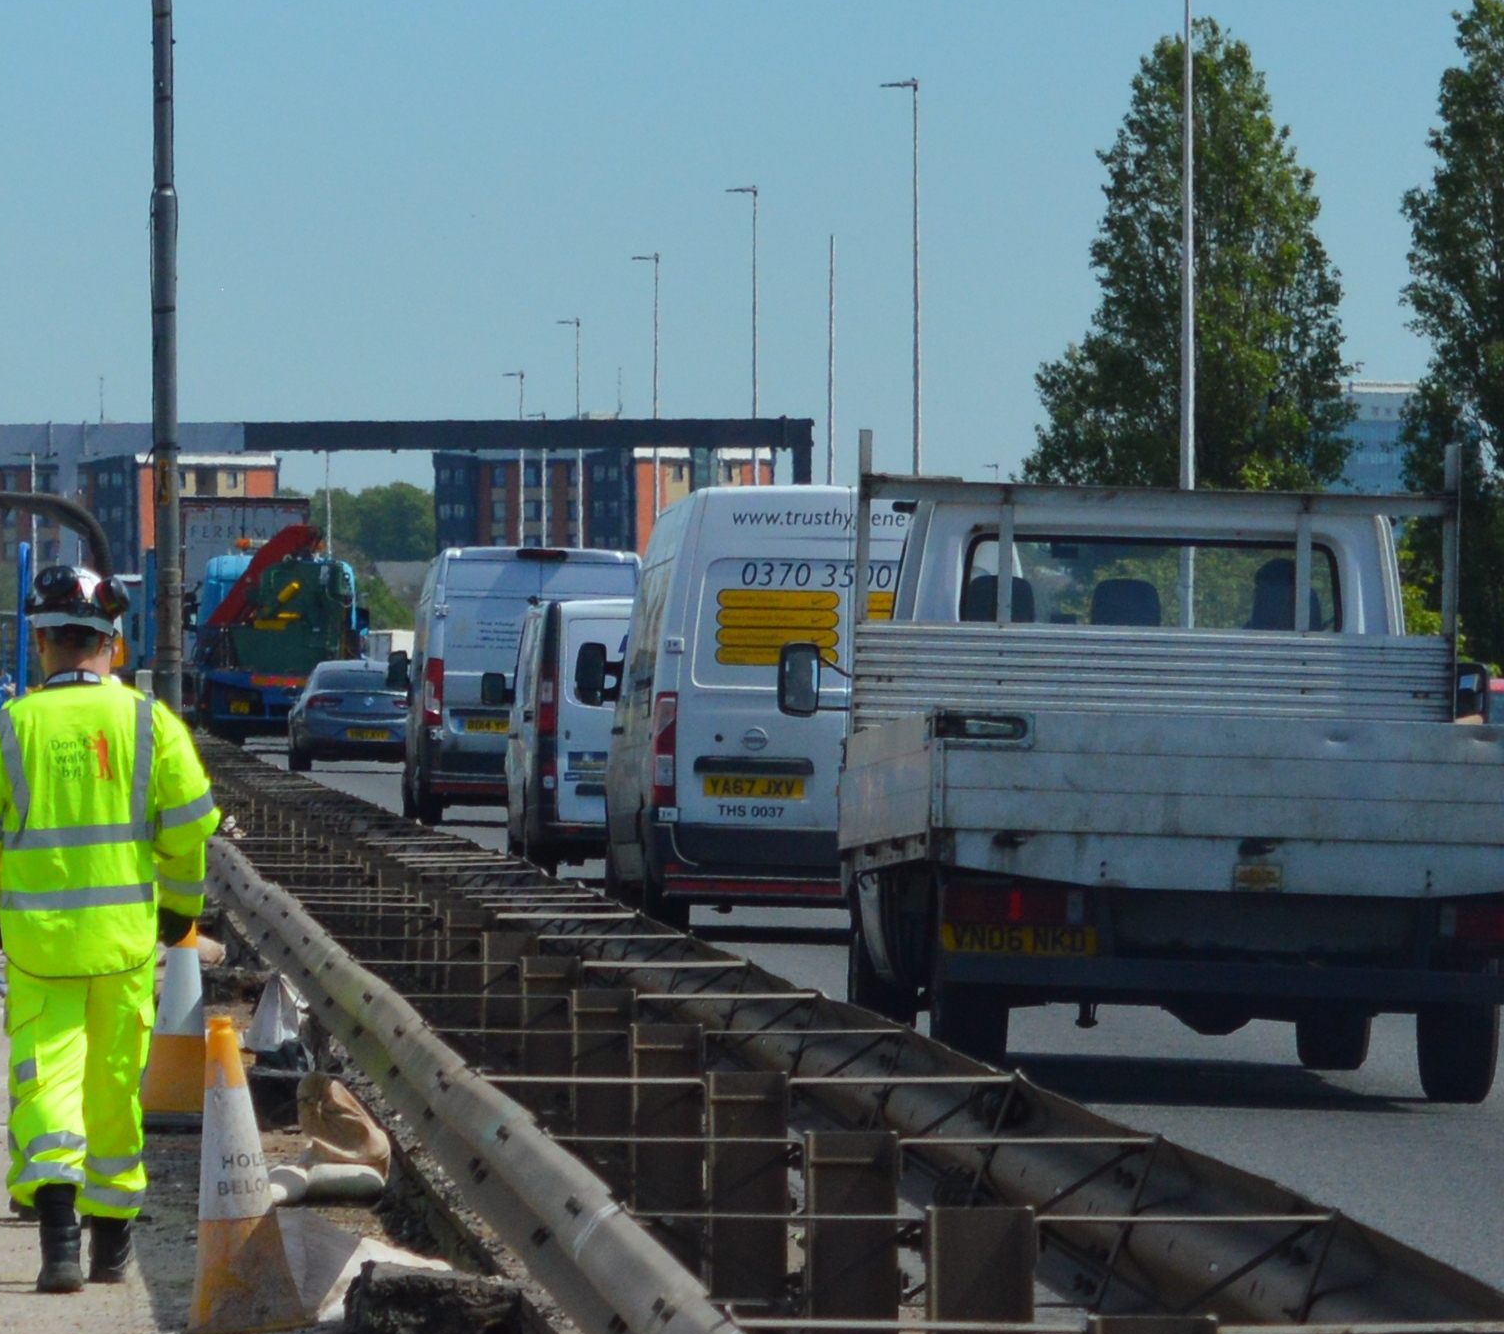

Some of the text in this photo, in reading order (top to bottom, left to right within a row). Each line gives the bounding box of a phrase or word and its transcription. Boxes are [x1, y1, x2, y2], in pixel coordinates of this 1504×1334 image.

[732, 507, 905, 530] www.trusthyene
[741, 561, 812, 587] 0370
[710, 778, 795, 797] YA67 JXV
[717, 805, 785, 818] THS 0037
[217, 1178, 266, 1196] BELO
